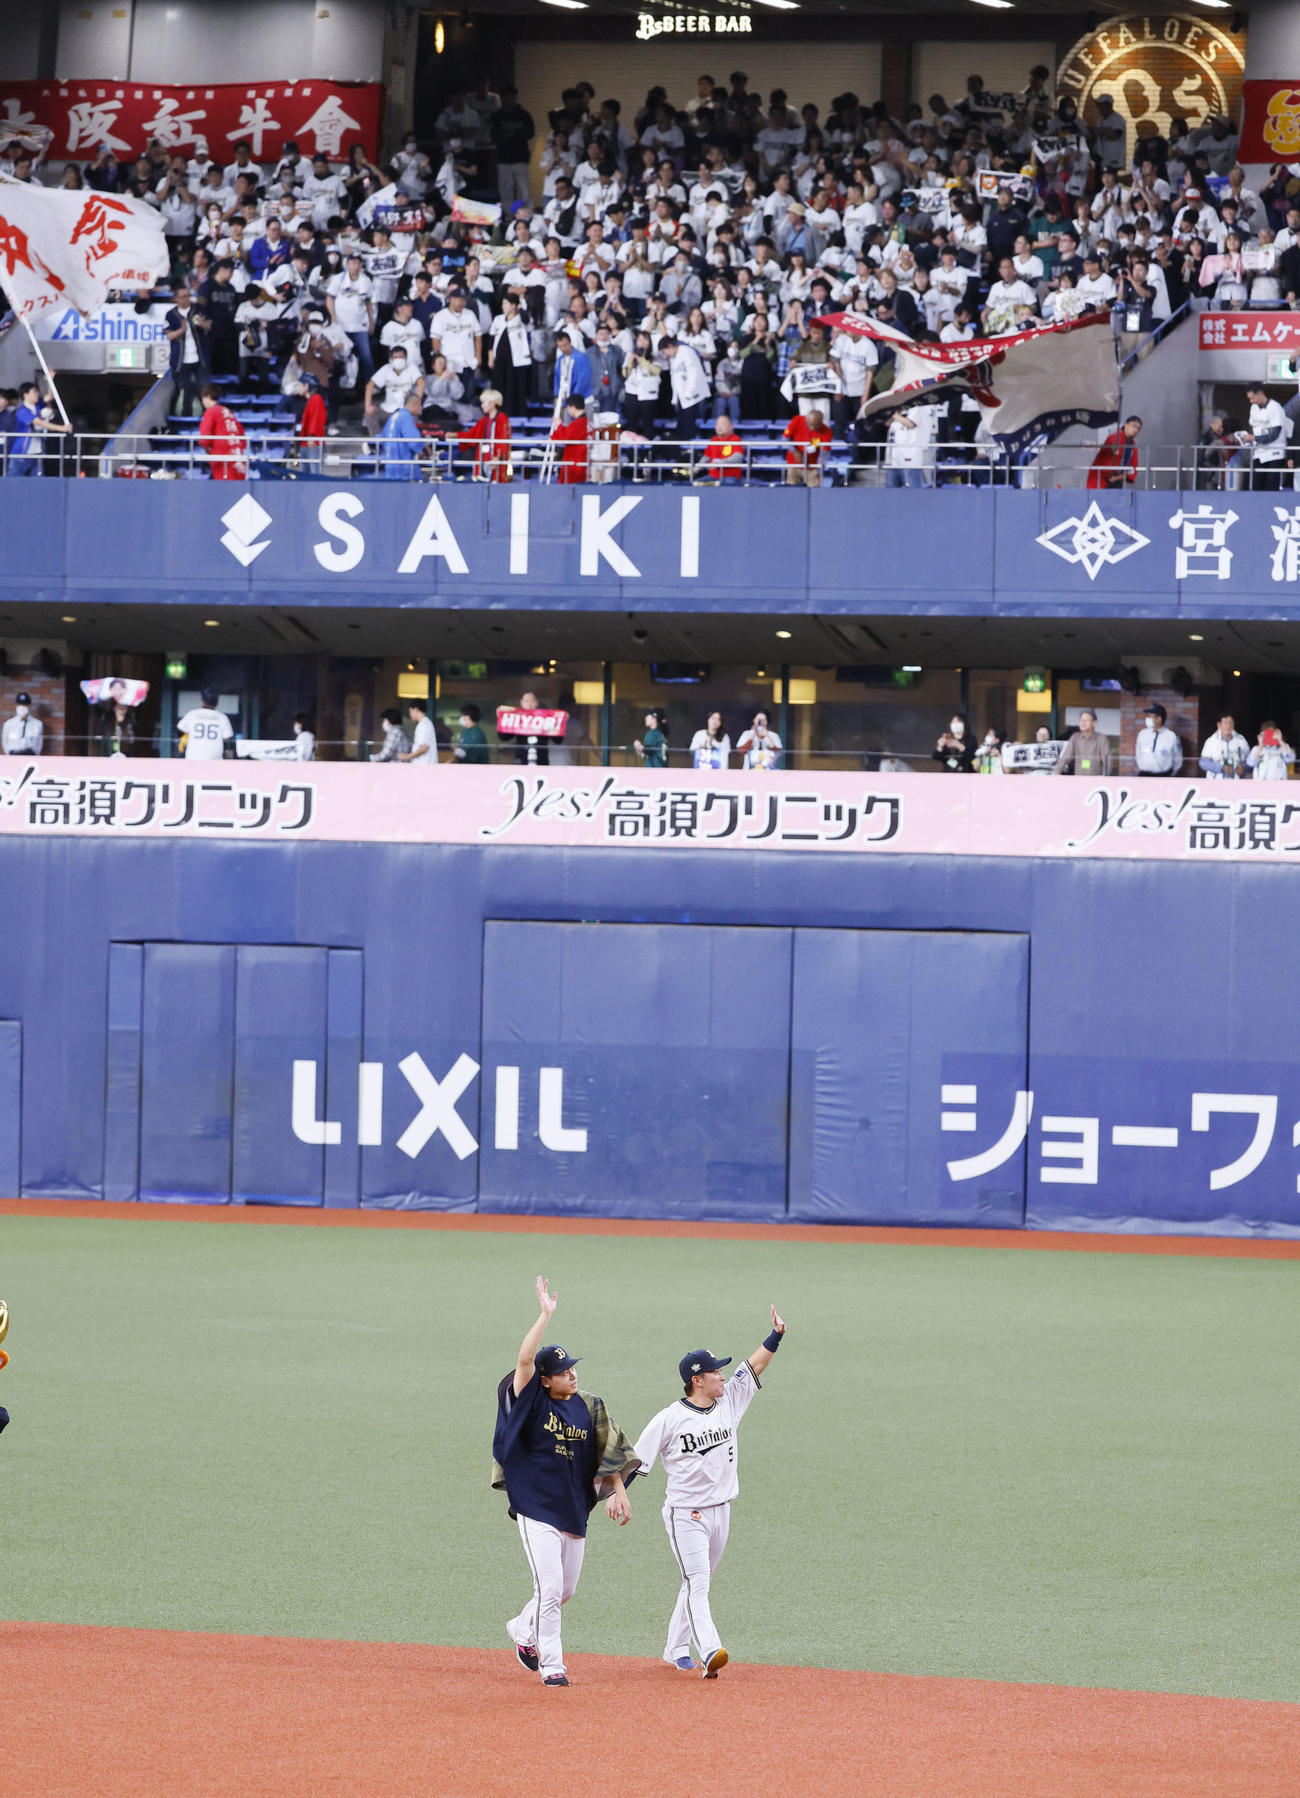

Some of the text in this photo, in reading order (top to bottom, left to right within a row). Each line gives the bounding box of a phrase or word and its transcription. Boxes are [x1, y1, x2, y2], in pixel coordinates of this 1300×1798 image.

[715, 15, 752, 32] BAR
[1057, 17, 1223, 100] UFFALOES
[313, 491, 701, 578] SAIKI
[193, 723, 219, 740] 96
[501, 713, 563, 731] HIYORI
[28, 779, 313, 830] 高須クリニック
[608, 789, 900, 842] 高須クリニック
[292, 1051, 588, 1161] LIXIL
[940, 1084, 1300, 1192] ショーワ
[554, 1347, 566, 1360] B
